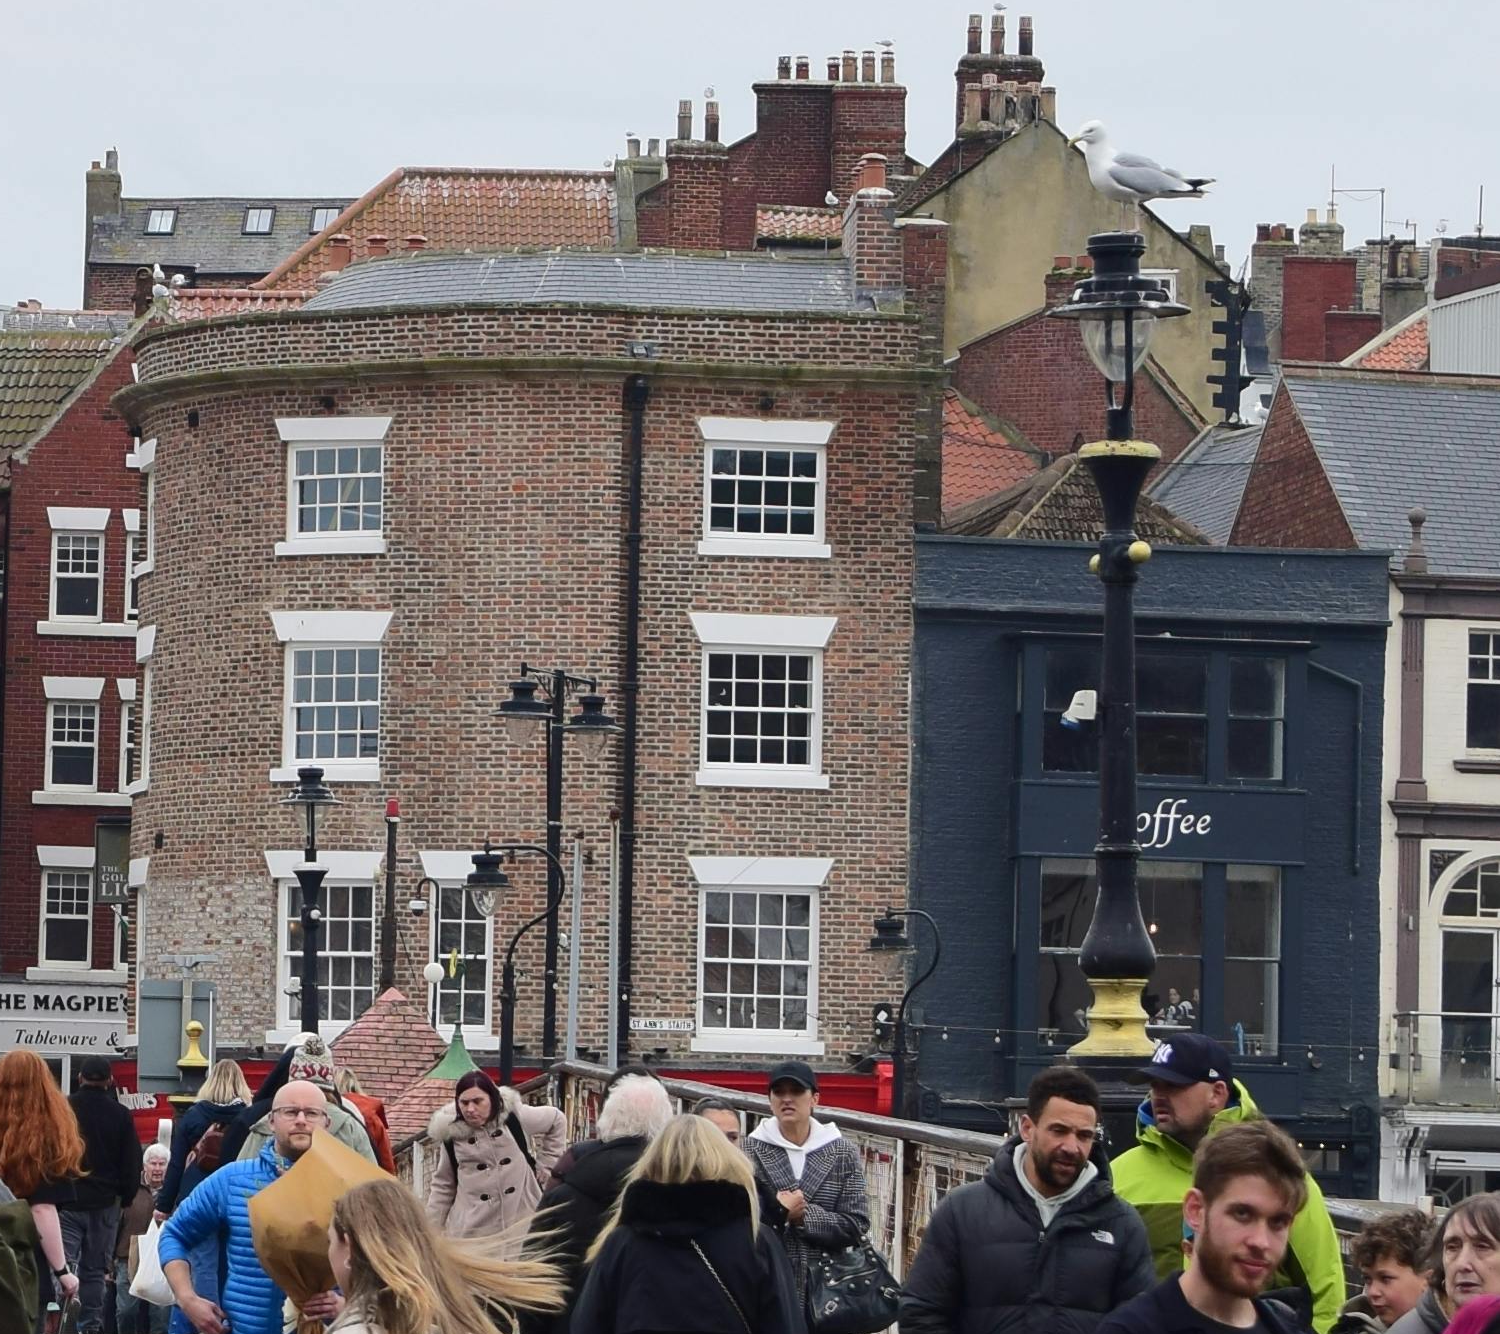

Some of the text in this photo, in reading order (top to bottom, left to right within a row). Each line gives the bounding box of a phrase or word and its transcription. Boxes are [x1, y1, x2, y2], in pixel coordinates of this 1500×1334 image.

[1136, 798, 1212, 848] offee
[101, 873, 127, 883] GOL
[101, 882, 129, 897] LI
[14, 1028, 120, 1047] Tableware &
